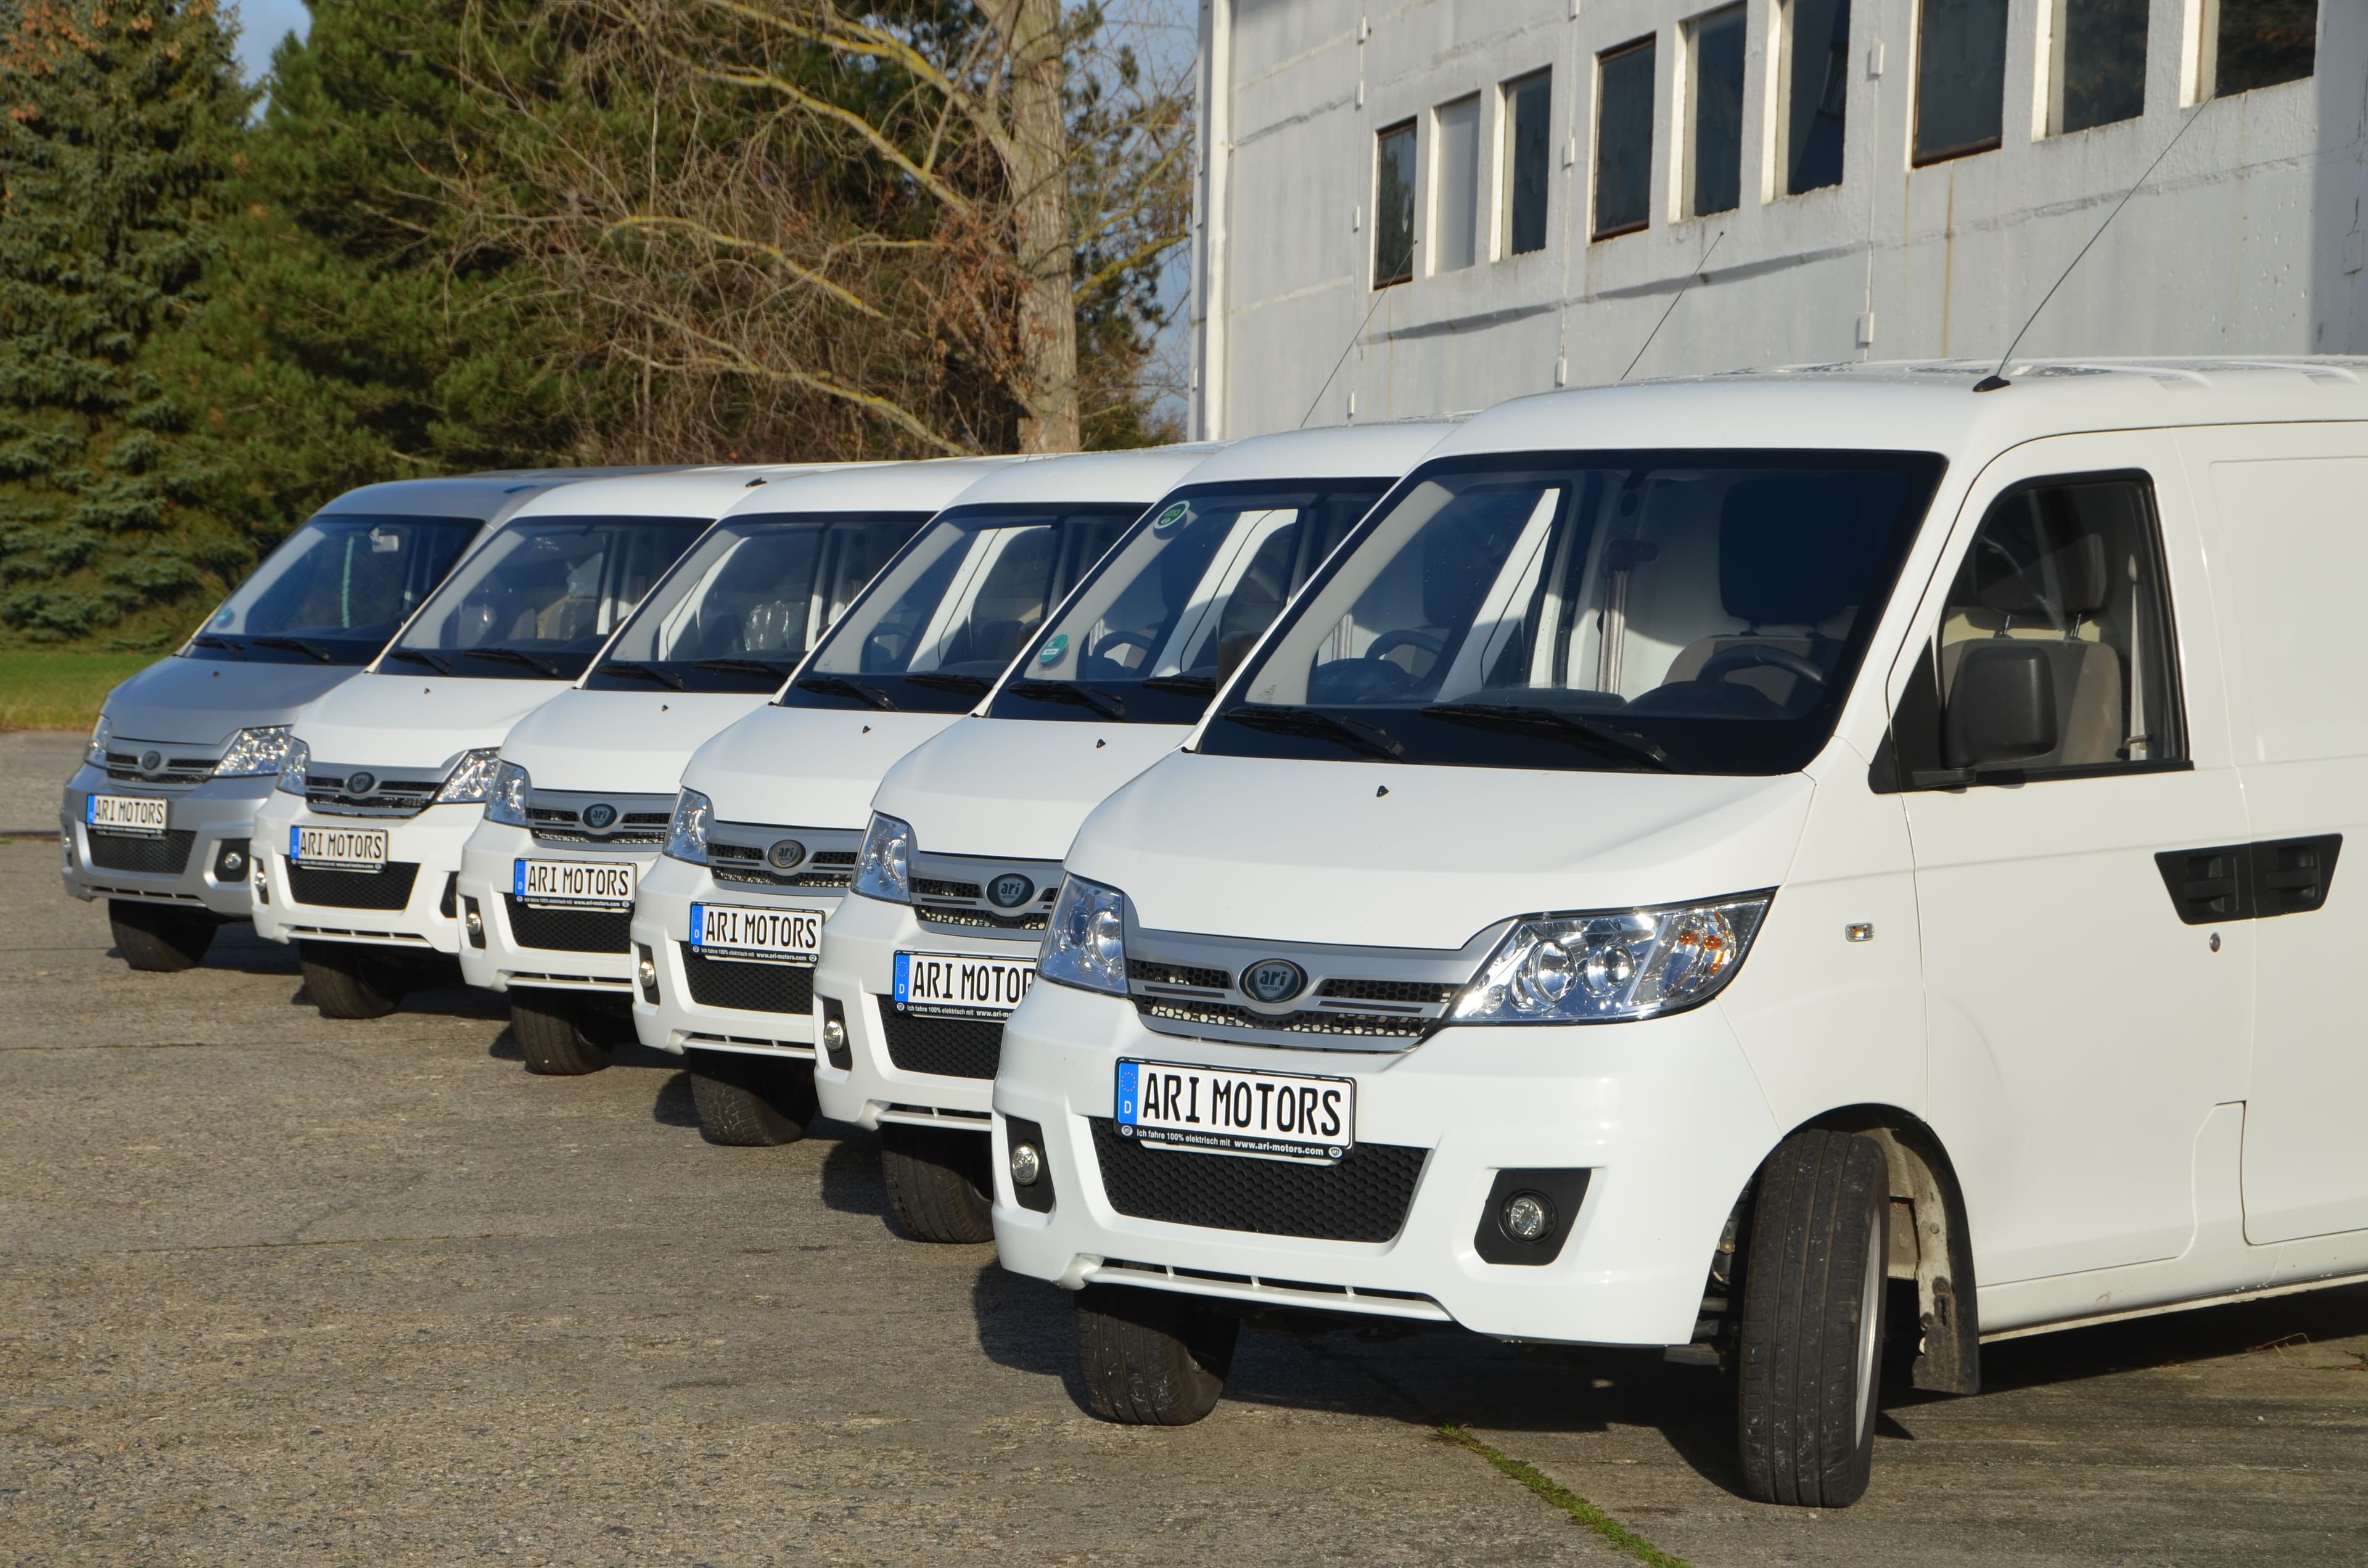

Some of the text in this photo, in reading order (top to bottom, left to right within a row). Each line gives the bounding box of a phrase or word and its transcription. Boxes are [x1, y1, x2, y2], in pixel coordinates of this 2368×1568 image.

[95, 799, 163, 824] ARI MOTORS
[593, 810, 607, 819] ari
[299, 832, 382, 859] ARI MOTORS
[778, 847, 795, 858] ari
[527, 866, 629, 896] ARI MOTORS
[1001, 882, 1021, 895] ari
[694, 929, 700, 938] D
[705, 911, 817, 948] ARI MOTORS
[898, 983, 905, 995] D
[912, 961, 953, 999] ARI
[1259, 970, 1288, 987] ari
[1124, 1100, 1132, 1114] D
[1143, 1072, 1341, 1137] ARI MOTORS
[1137, 1128, 1324, 1155] Ich fahre 100% elektrisch mit www.ari-motors.com
